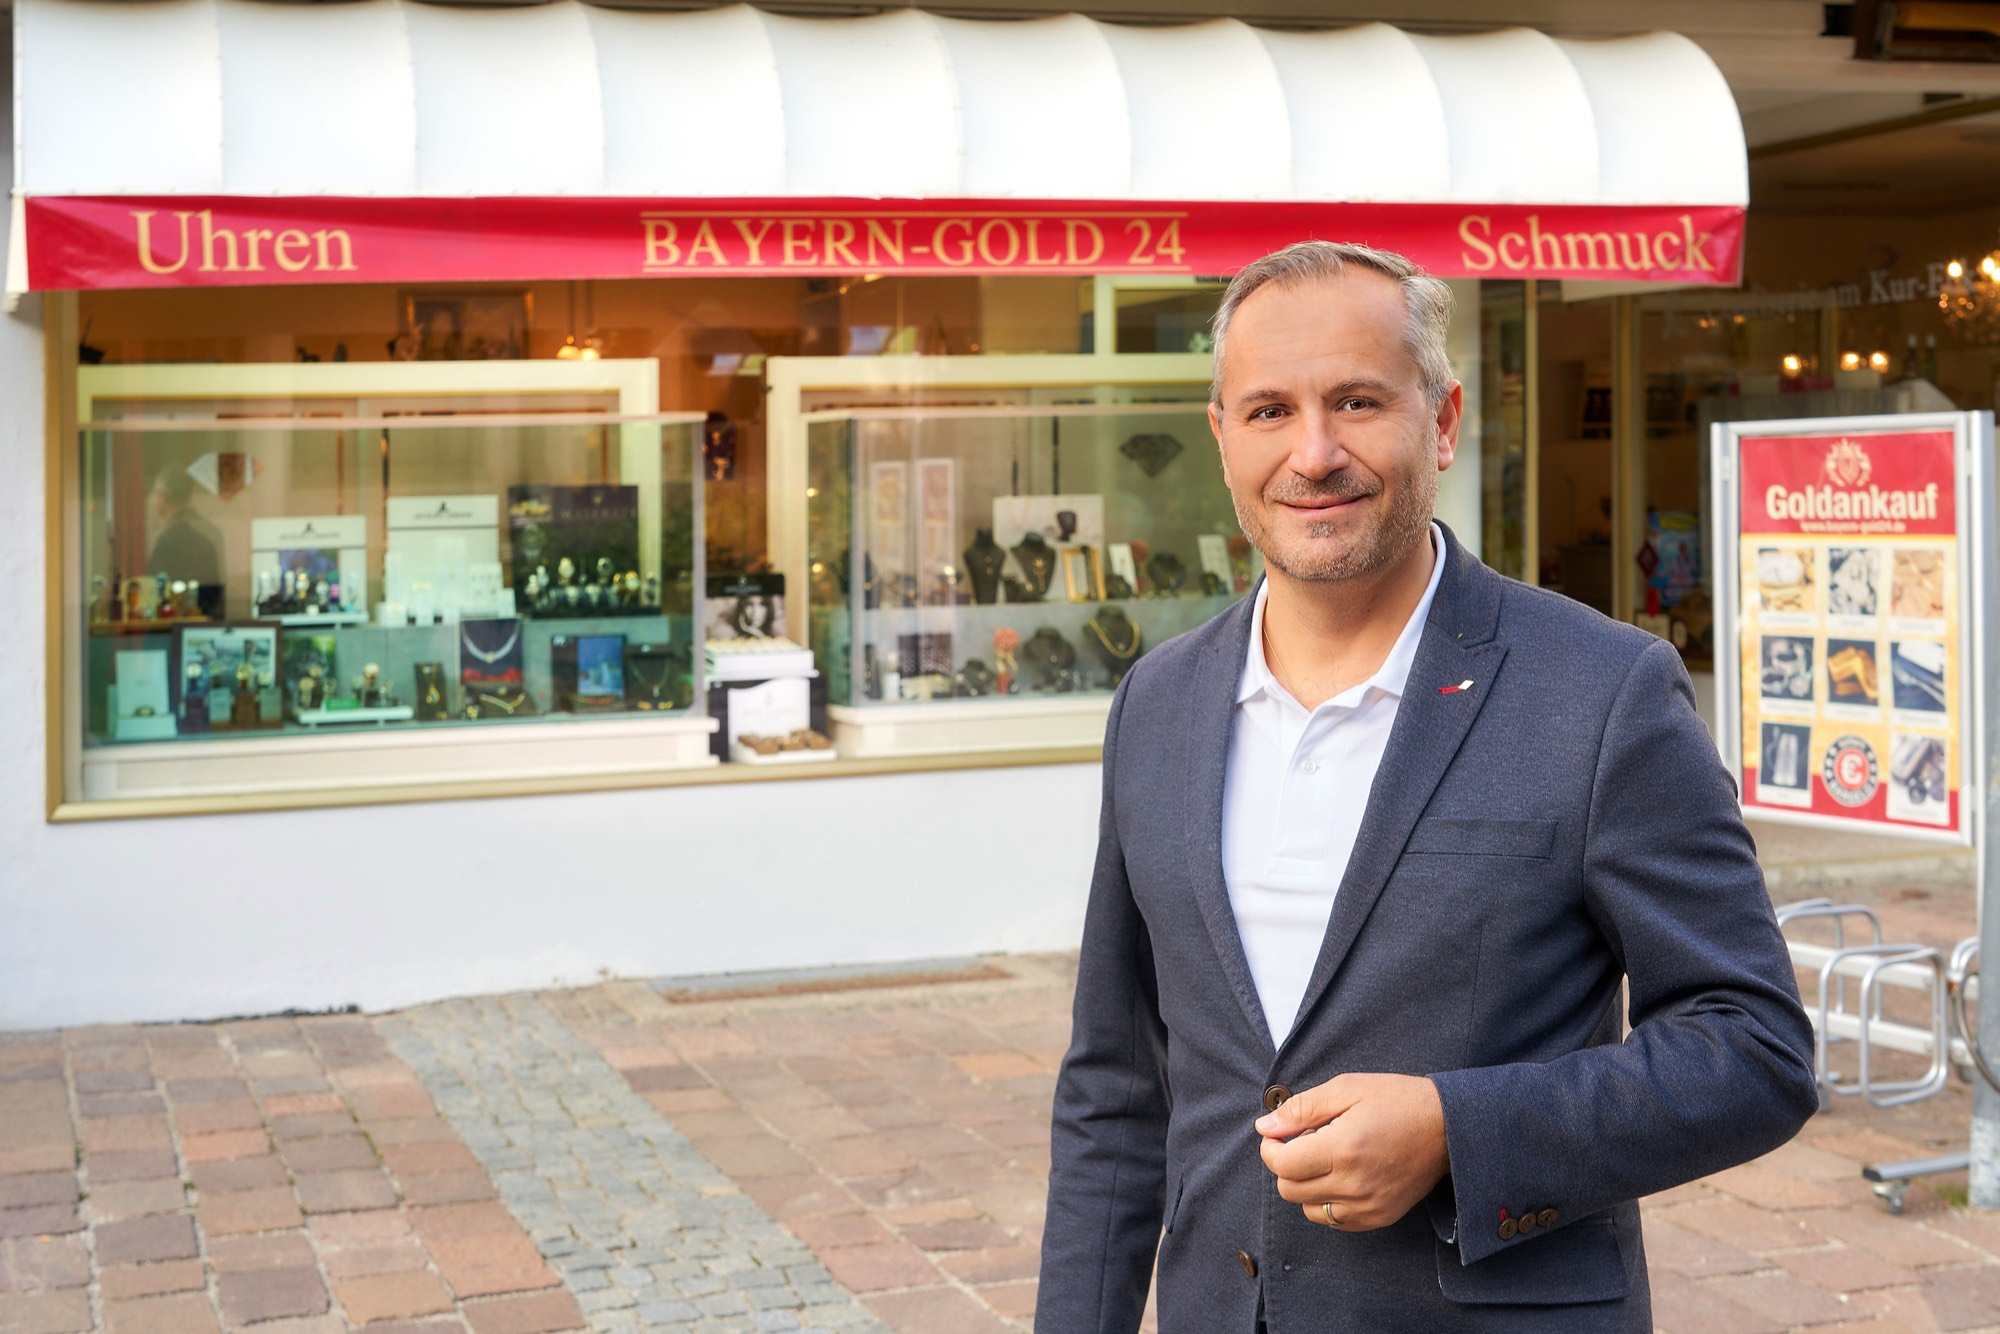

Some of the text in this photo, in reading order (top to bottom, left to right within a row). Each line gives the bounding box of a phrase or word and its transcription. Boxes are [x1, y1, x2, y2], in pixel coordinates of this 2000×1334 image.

[130, 209, 359, 275] Uhren
[643, 217, 1187, 268] BAYERN-GOLD 24
[1457, 213, 1715, 273] Schmuck
[1765, 483, 1938, 520] Goldankauf
